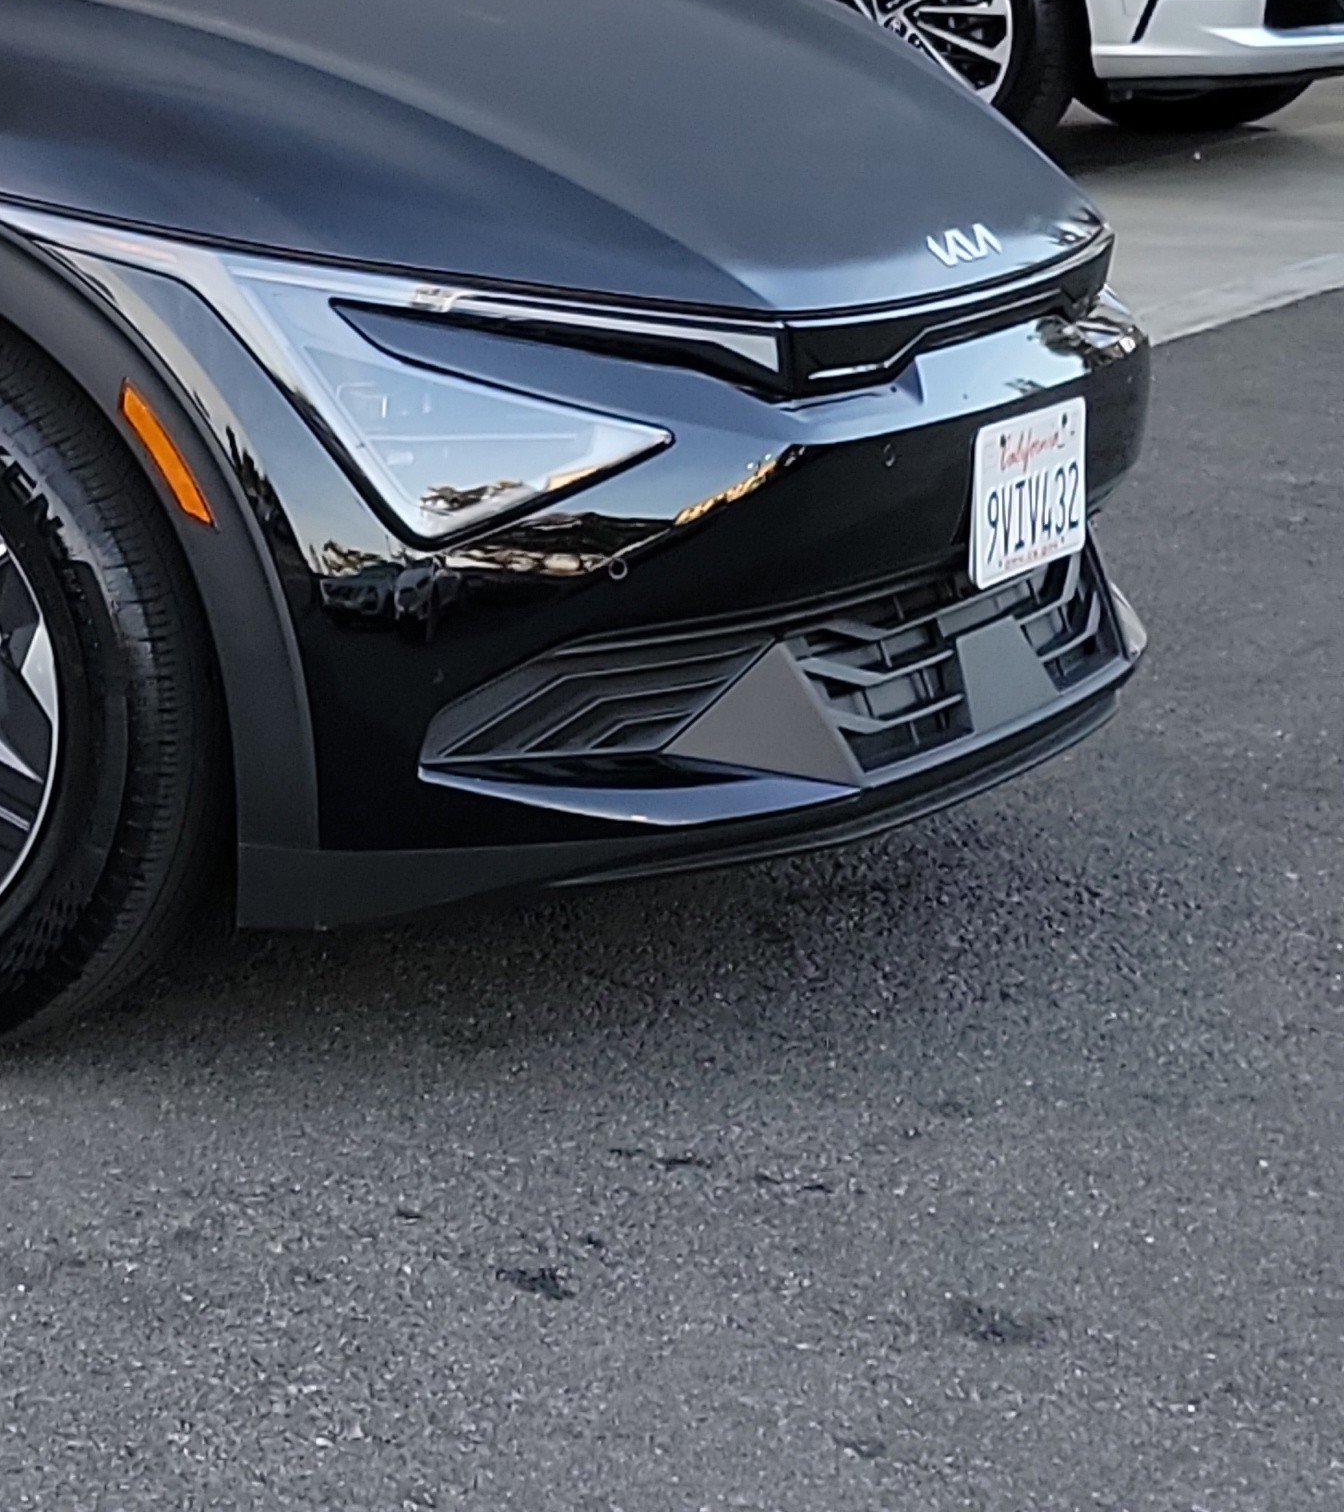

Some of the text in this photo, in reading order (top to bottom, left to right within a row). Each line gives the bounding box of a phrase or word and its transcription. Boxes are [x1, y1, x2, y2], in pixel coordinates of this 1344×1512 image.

[926, 222, 1003, 267] KIA
[1000, 428, 1065, 472] California
[987, 460, 1079, 566] 9VIV432
